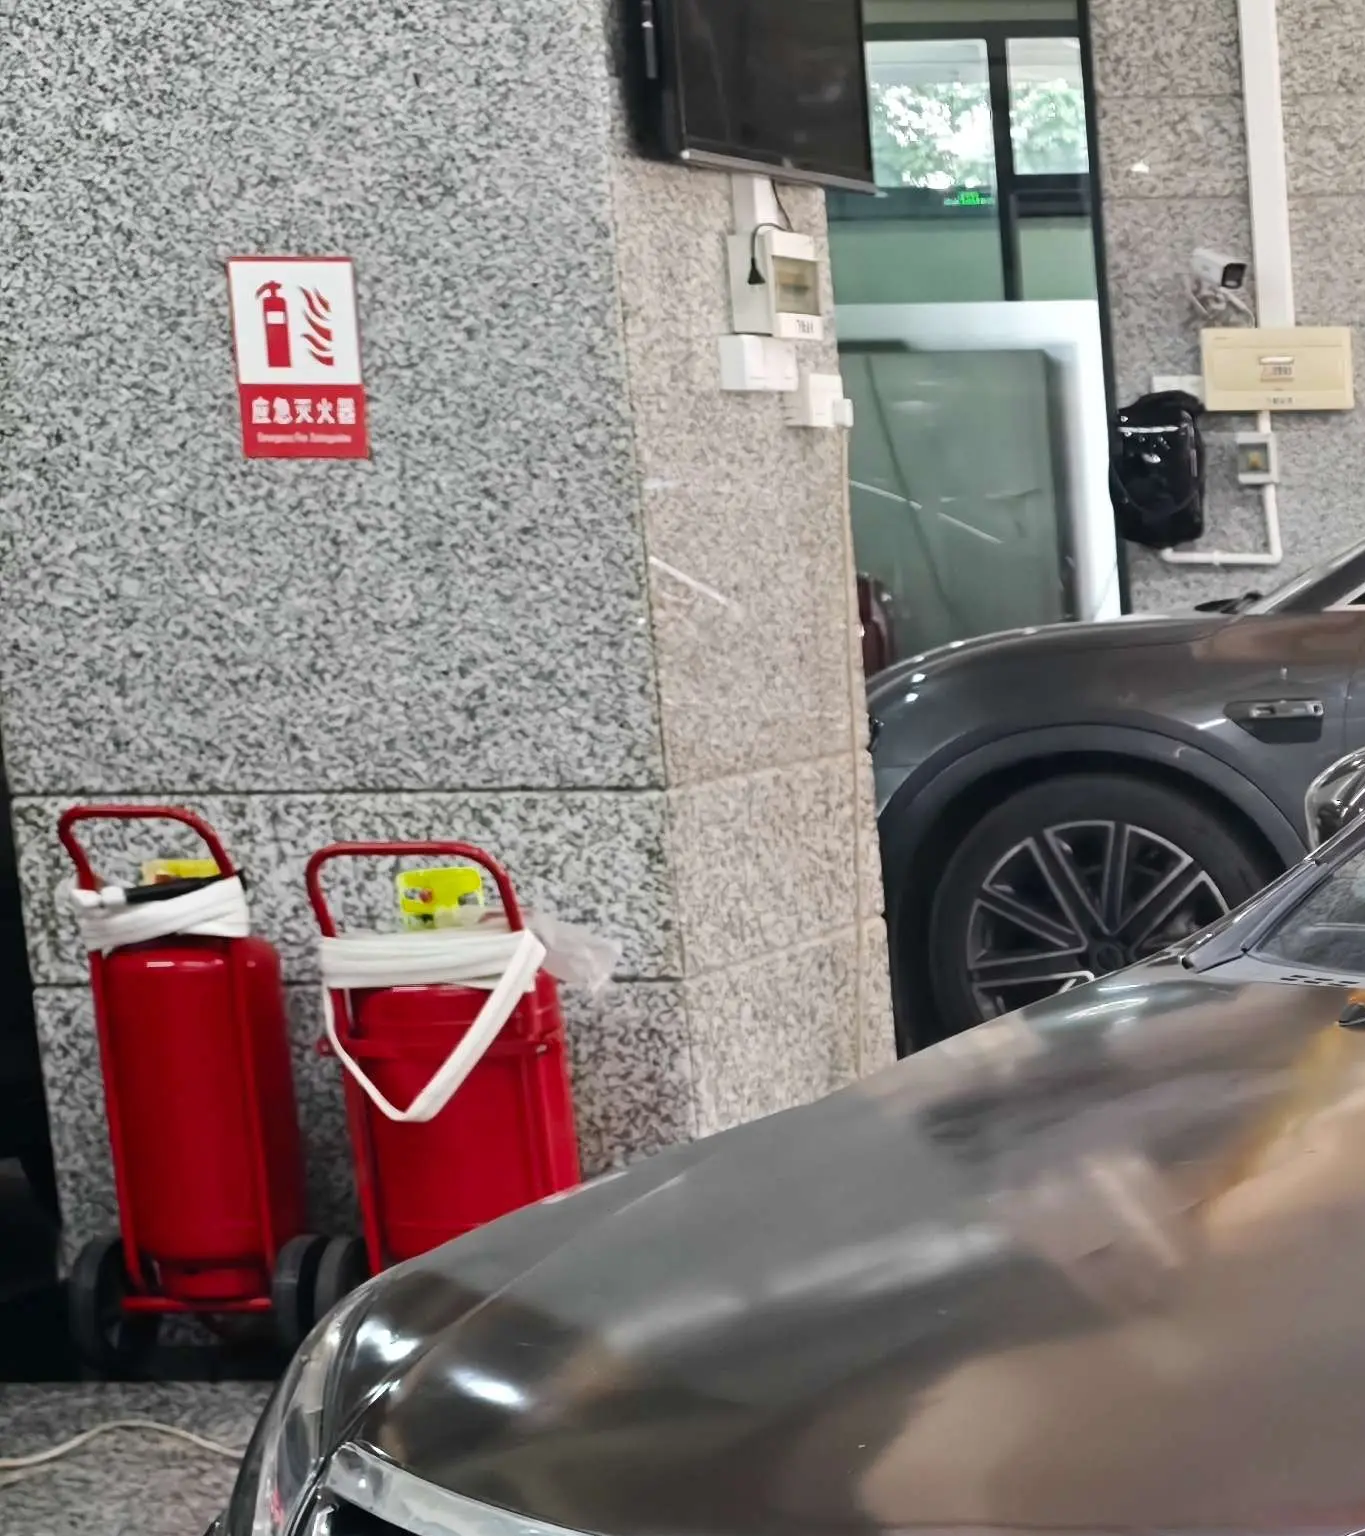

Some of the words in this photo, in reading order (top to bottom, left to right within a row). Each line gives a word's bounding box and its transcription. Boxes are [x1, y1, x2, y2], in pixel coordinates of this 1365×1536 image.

[251, 395, 356, 425] 应急灭火器
